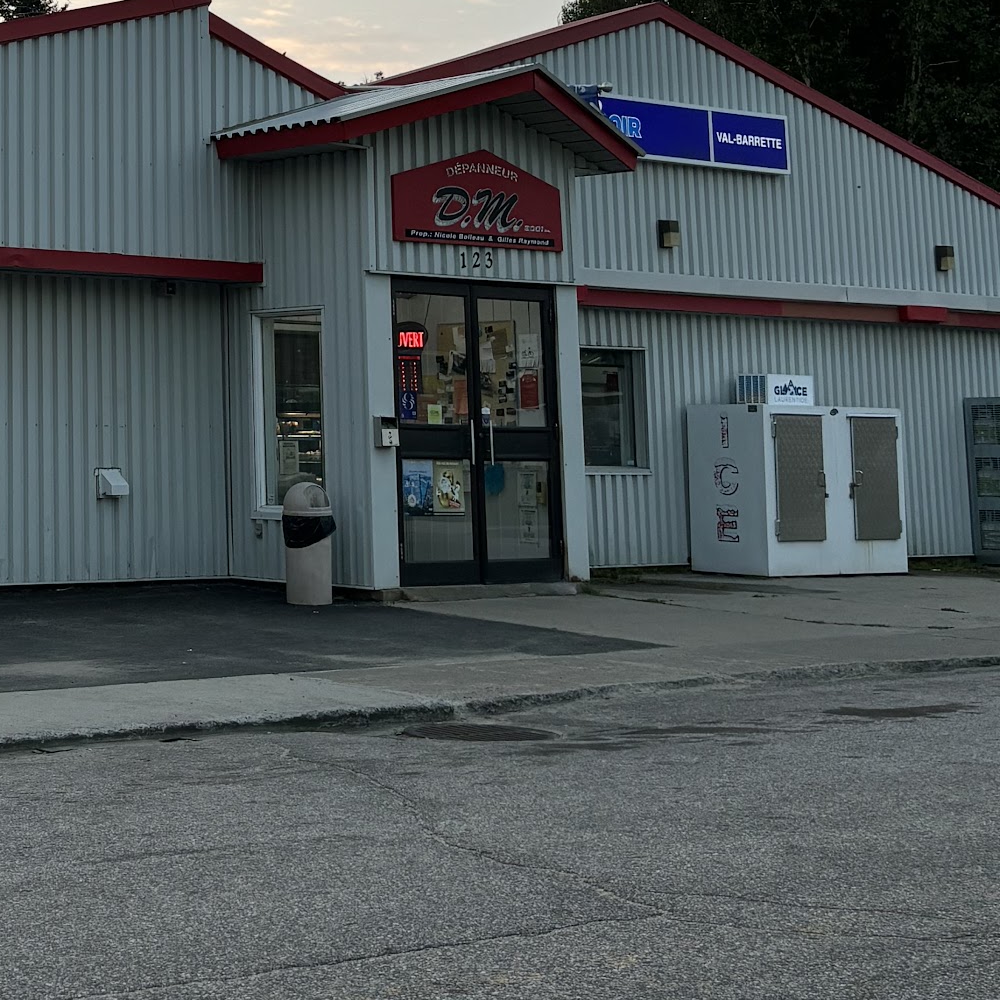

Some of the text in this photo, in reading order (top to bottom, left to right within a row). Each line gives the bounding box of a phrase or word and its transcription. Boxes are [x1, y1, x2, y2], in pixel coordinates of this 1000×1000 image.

[715, 131, 783, 150] VAL-BARRETTE
[445, 162, 519, 183] DÉPANNEUR
[434, 231, 457, 240] Nicole
[497, 236, 517, 244] Gilles
[517, 237, 550, 247] Raymond
[460, 251, 493, 269] 123
